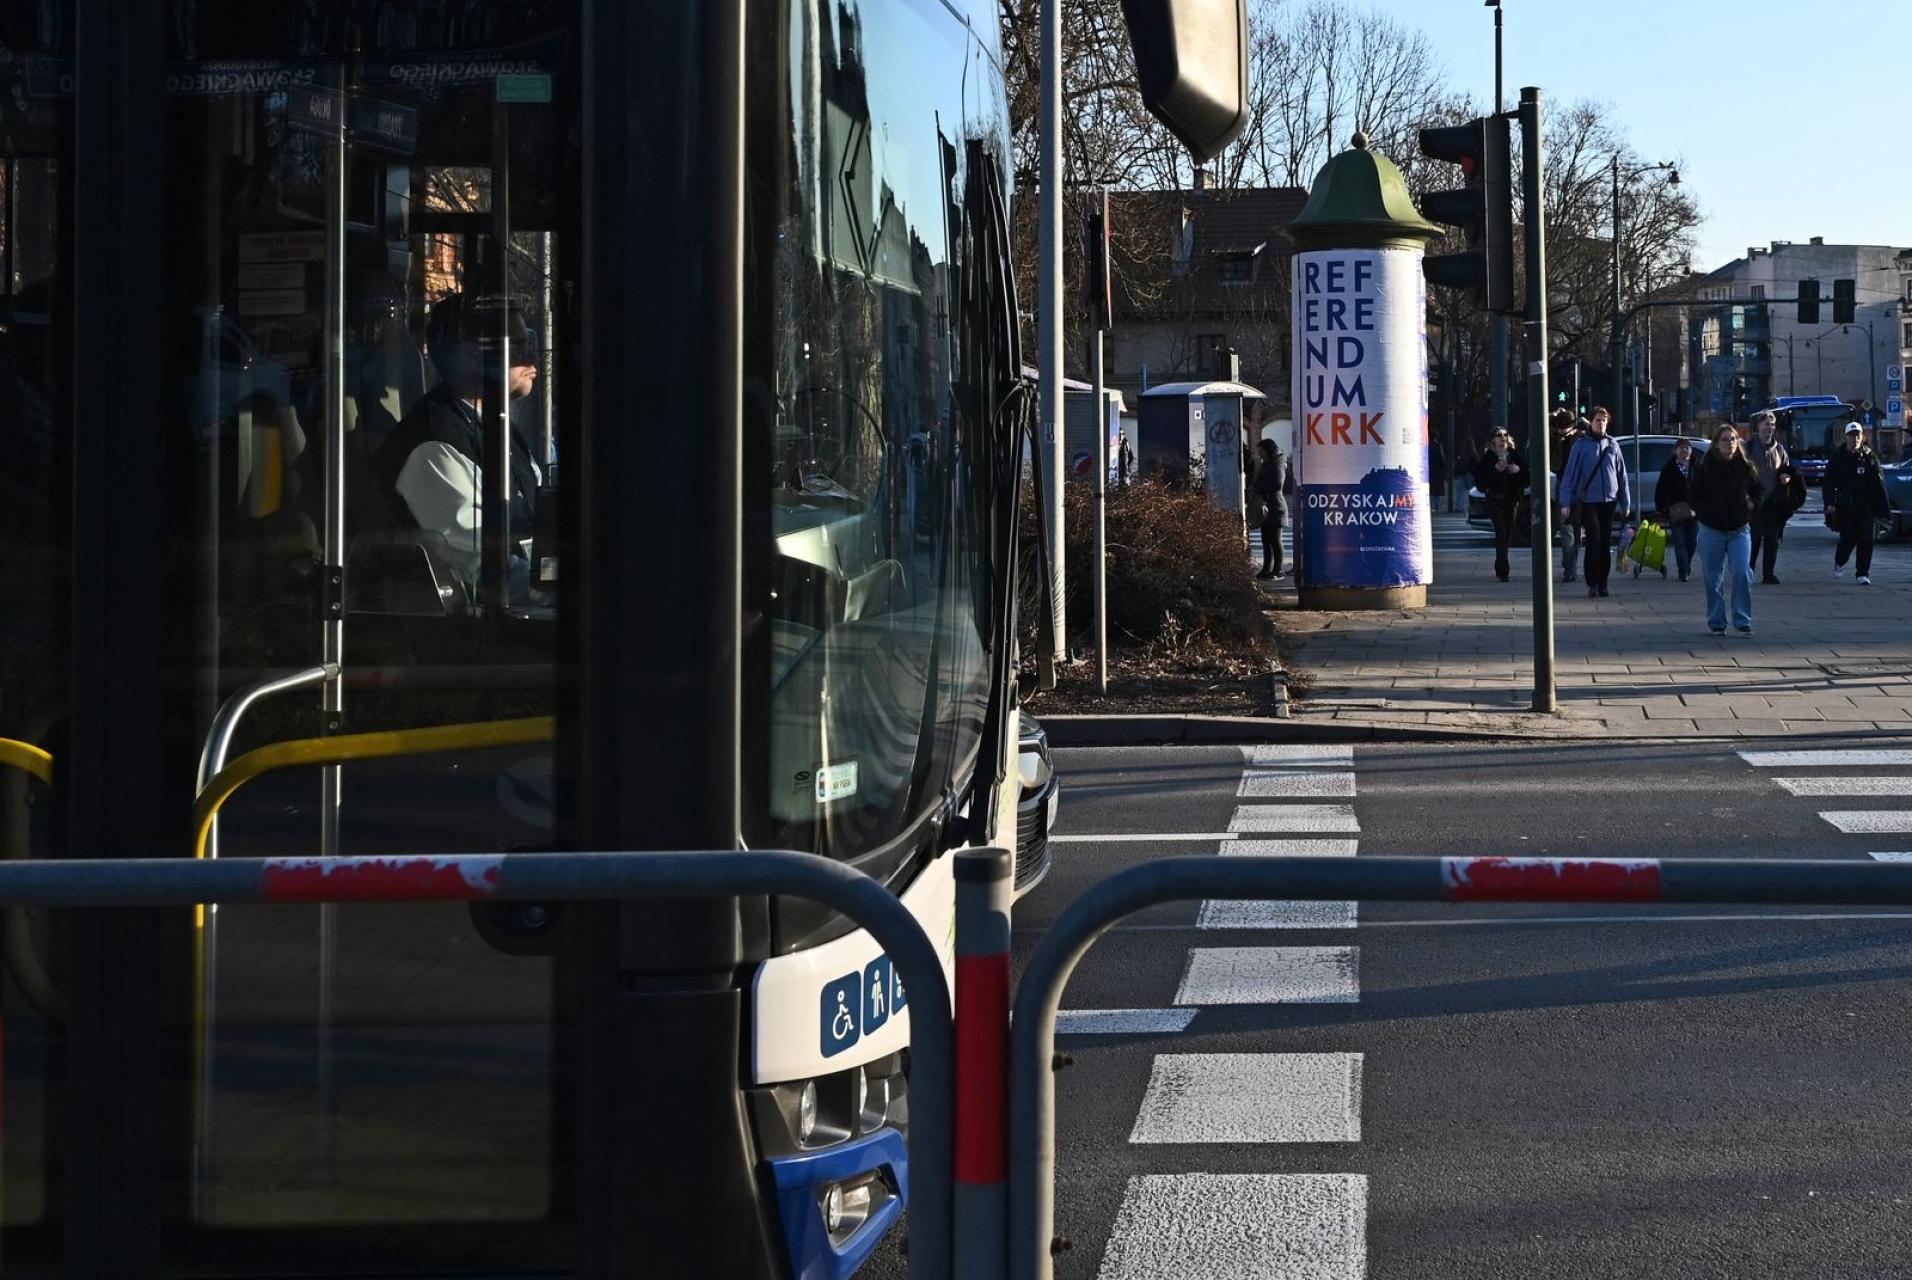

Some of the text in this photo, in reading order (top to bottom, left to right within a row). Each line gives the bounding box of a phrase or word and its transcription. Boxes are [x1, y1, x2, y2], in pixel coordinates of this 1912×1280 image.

[1305, 260, 1373, 294] REF
[1305, 298, 1374, 332] ERE
[1306, 336, 1365, 370] ND
[1306, 374, 1367, 408] UM
[1306, 412, 1385, 446] KRK
